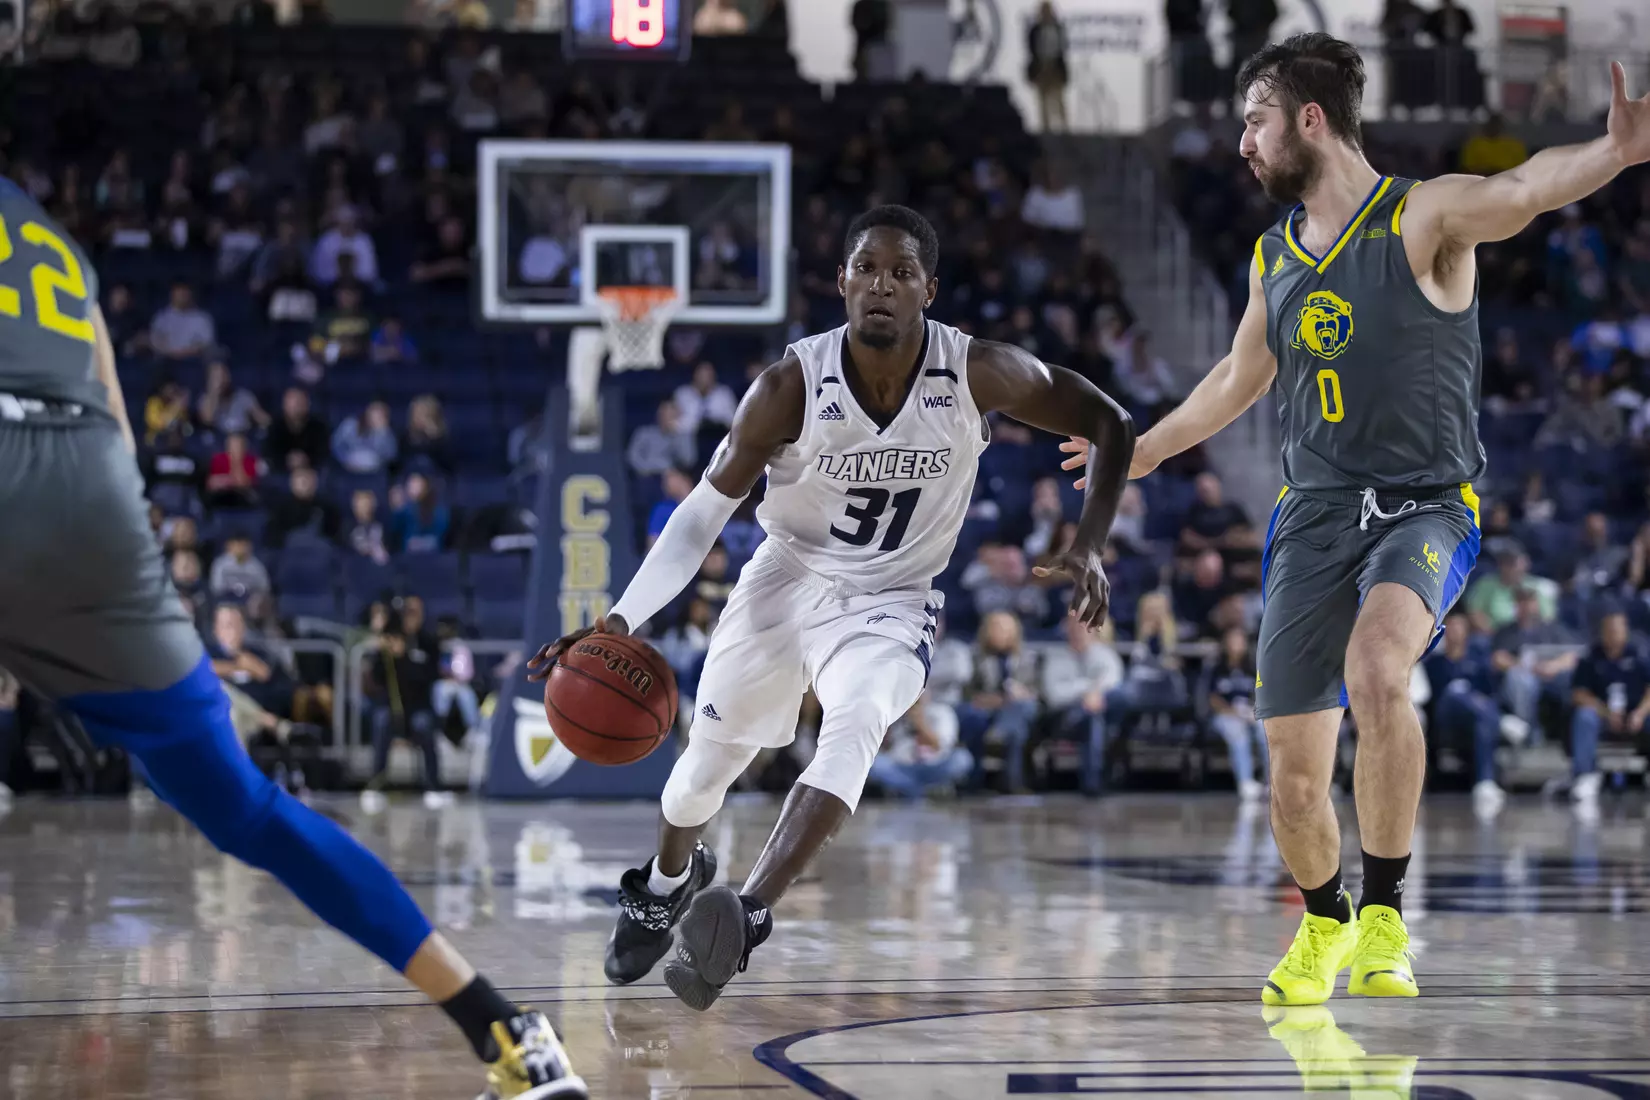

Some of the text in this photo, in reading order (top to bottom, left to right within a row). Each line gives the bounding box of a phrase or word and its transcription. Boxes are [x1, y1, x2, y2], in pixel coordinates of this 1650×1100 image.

[611, 0, 665, 48] 18
[922, 395, 953, 409] WAC
[1316, 368, 1345, 423] 0
[818, 448, 950, 482] LANCERS
[829, 487, 922, 551] 31
[574, 642, 654, 698] Wilson
